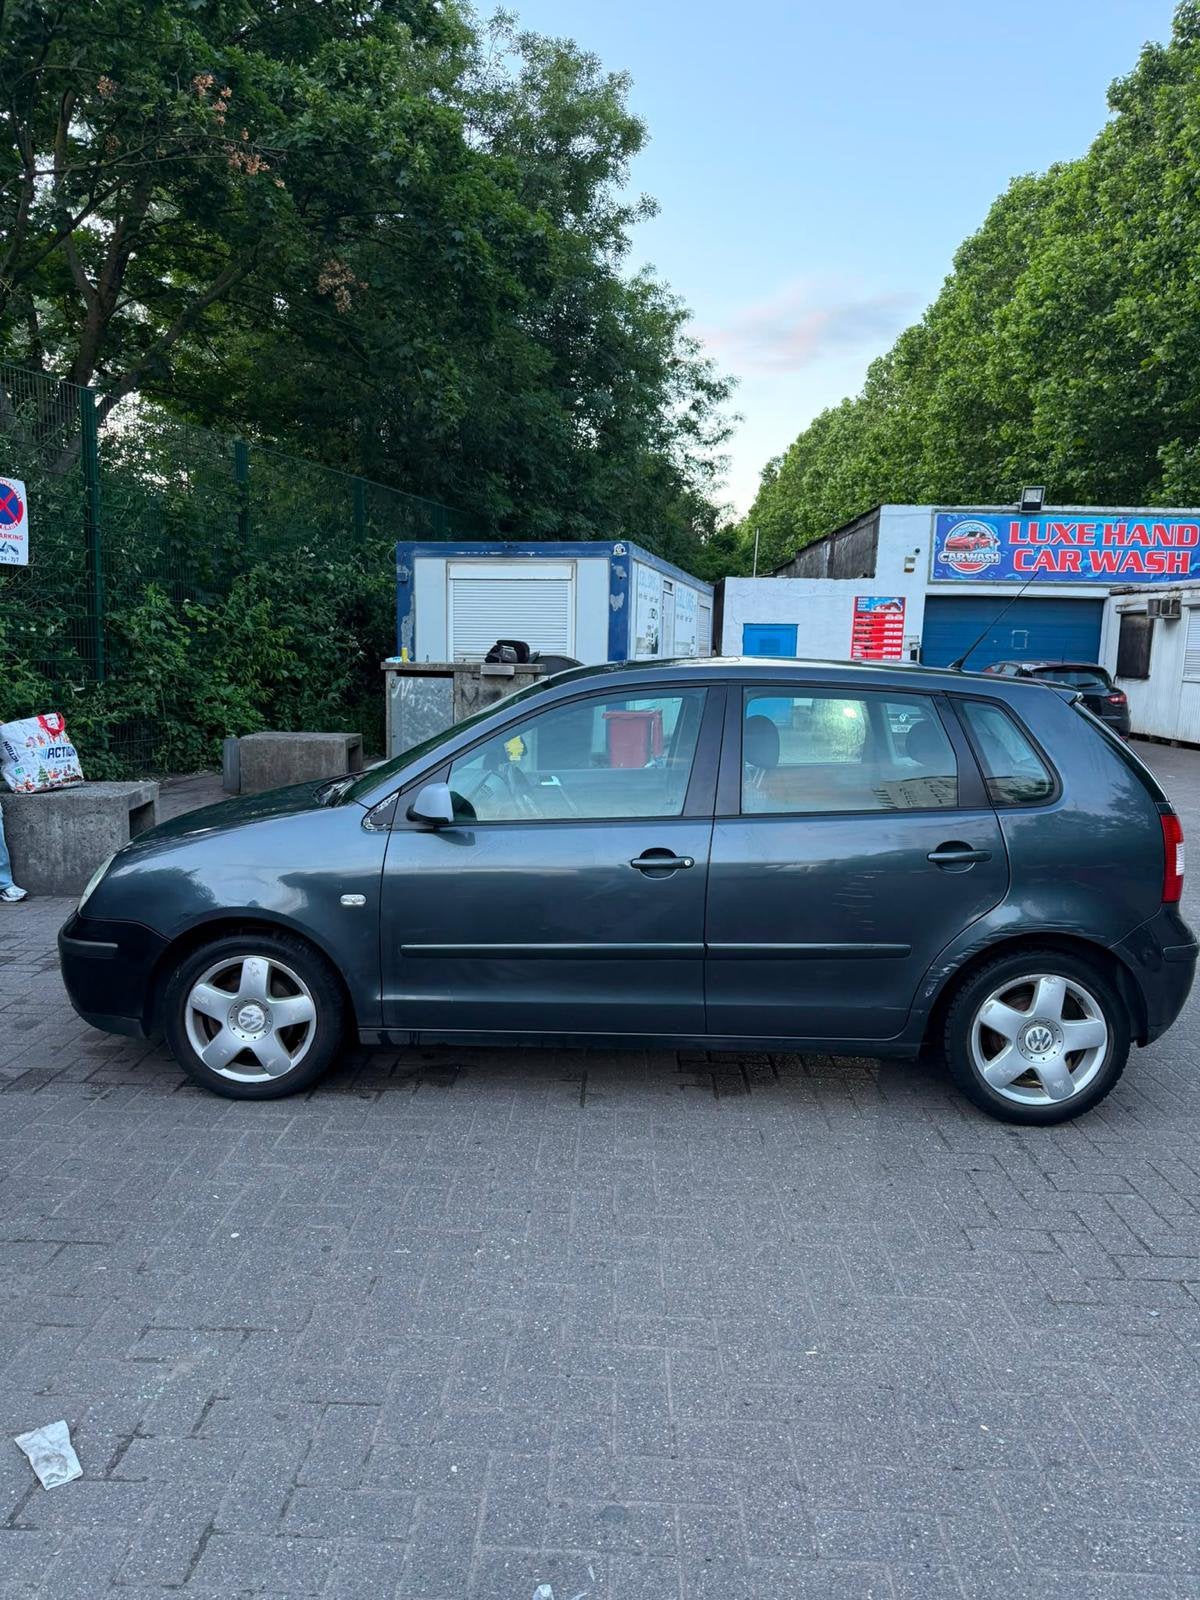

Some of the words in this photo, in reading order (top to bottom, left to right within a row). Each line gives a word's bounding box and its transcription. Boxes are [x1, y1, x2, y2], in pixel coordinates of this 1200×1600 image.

[1009, 521, 1096, 545] LUXE
[1102, 522, 1200, 547] HAND
[1013, 549, 1082, 572] CAR
[1089, 550, 1191, 574] WASH
